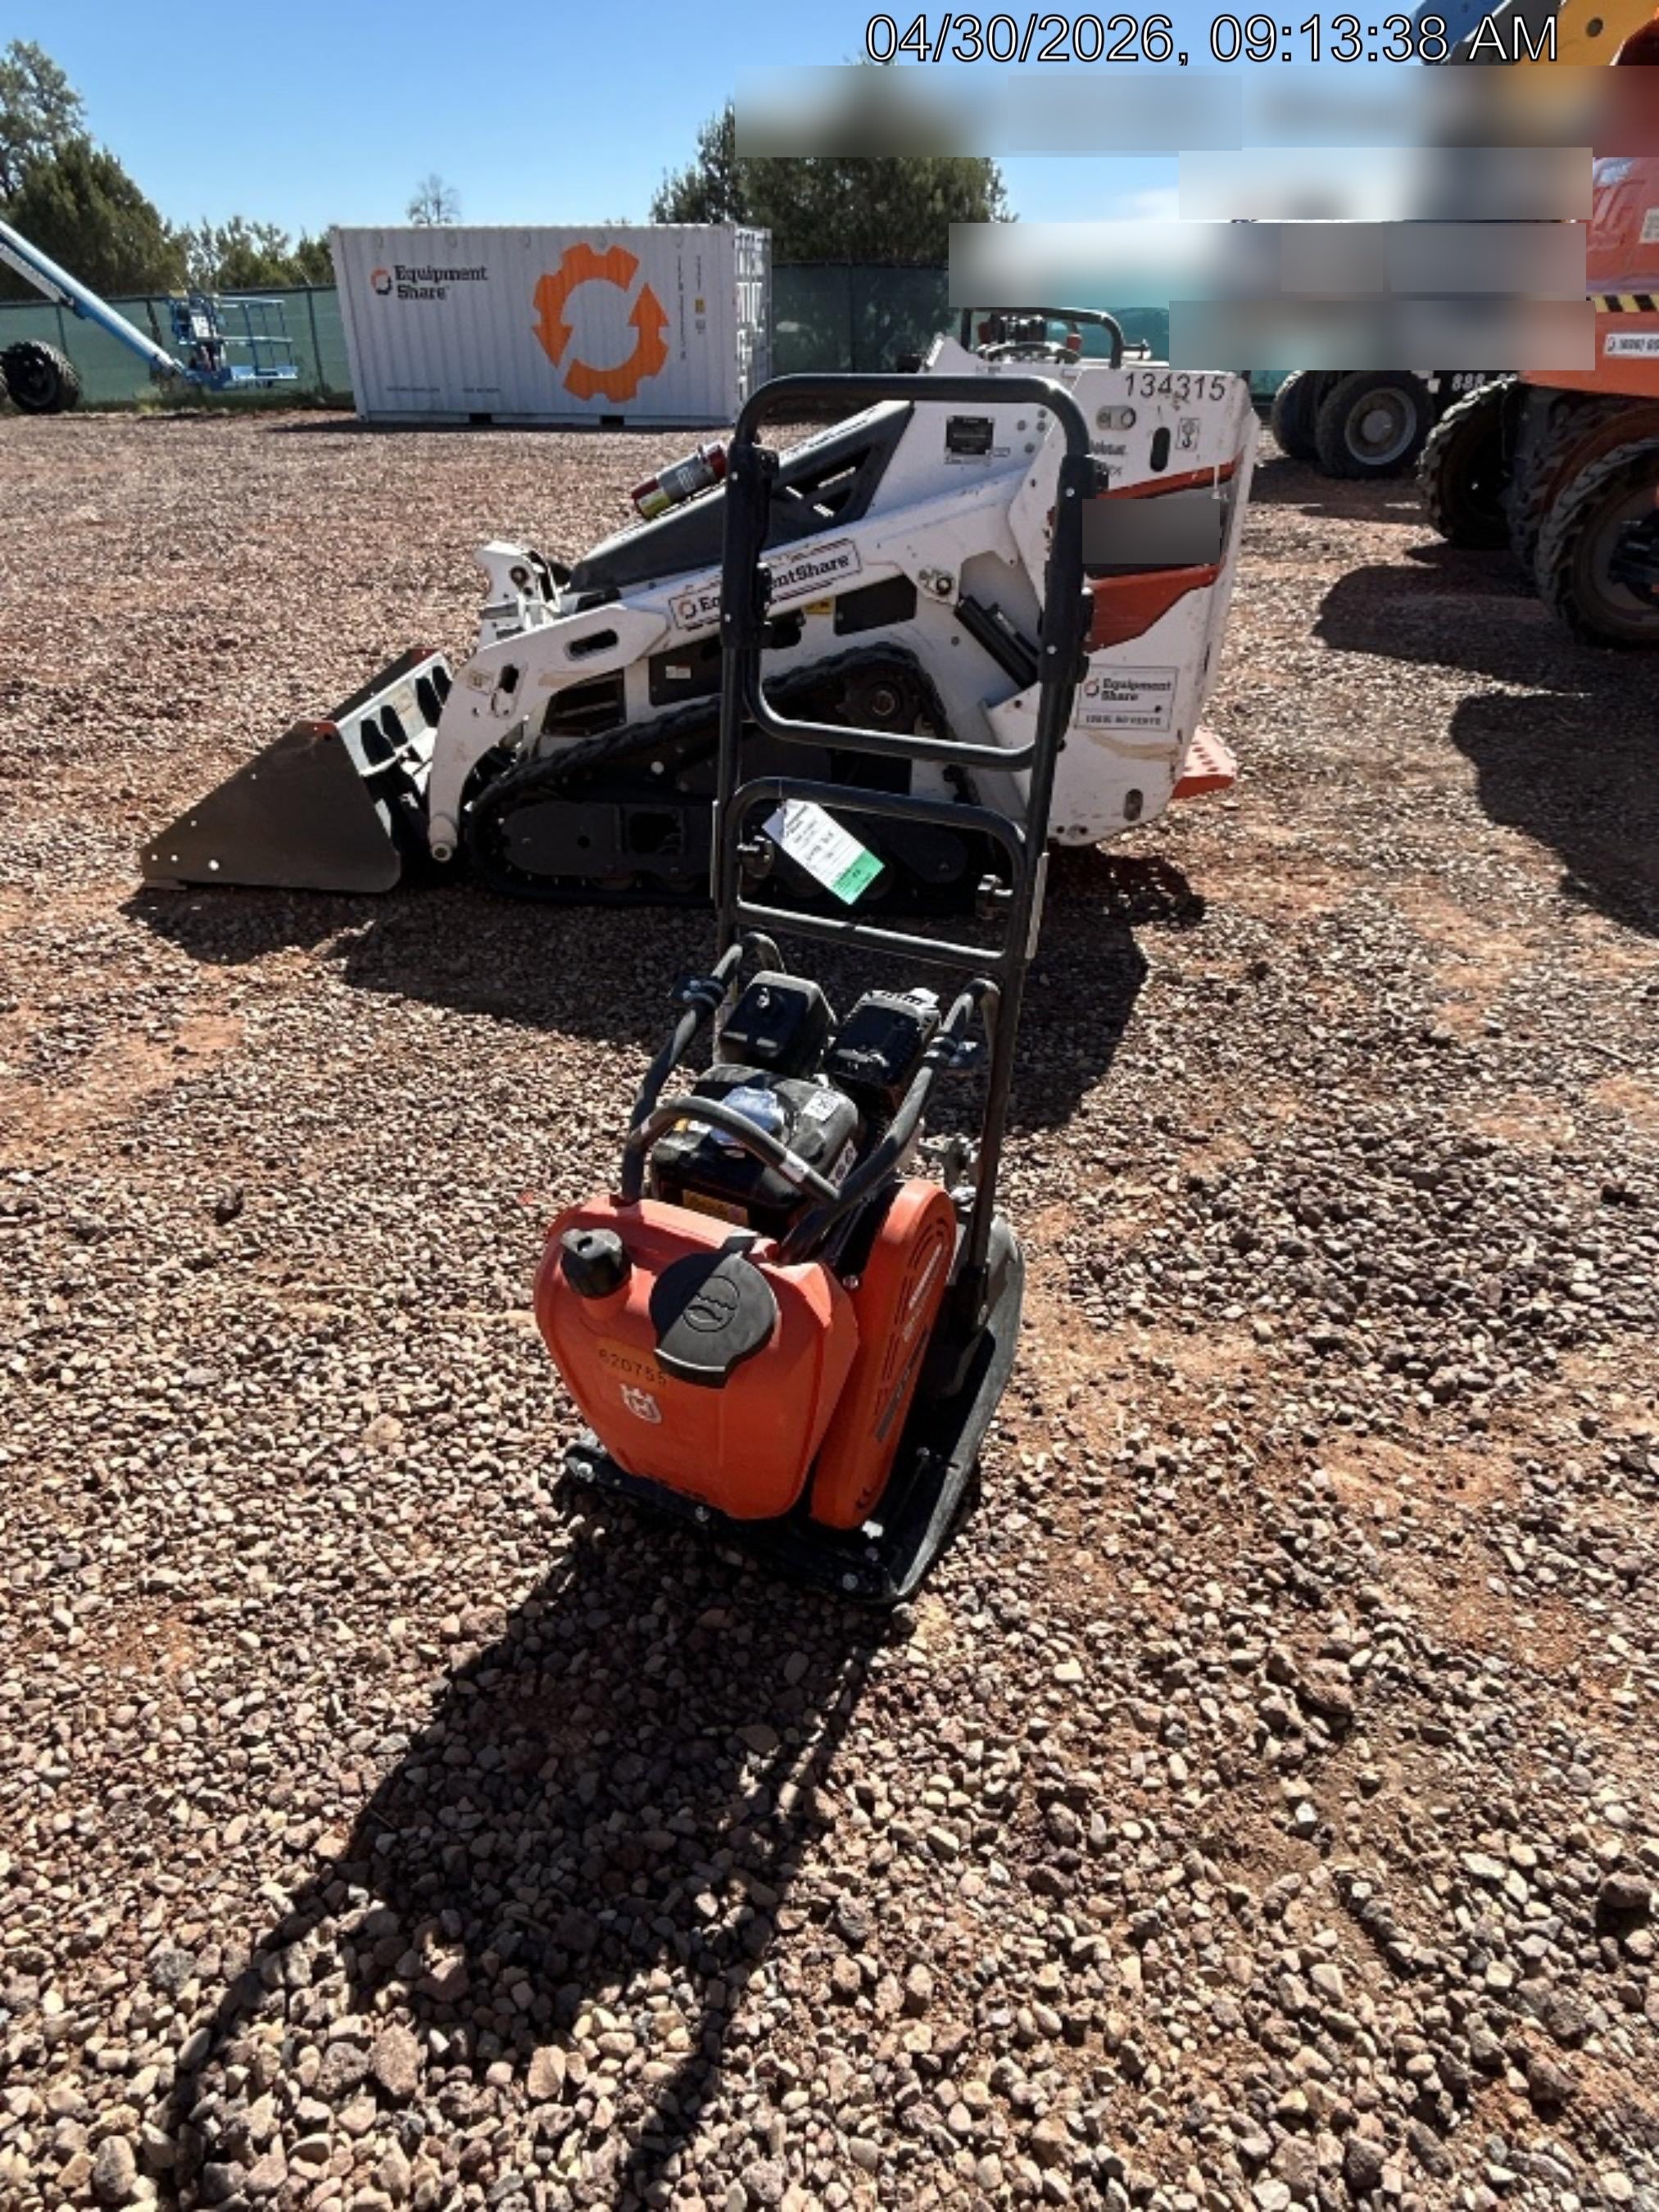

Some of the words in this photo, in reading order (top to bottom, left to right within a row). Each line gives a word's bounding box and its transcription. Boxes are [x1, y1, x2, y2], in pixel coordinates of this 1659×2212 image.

[393, 265, 488, 283] Equipment
[397, 285, 446, 300] Share
[1126, 372, 1226, 401] 134315
[1103, 678, 1171, 691] Equipment
